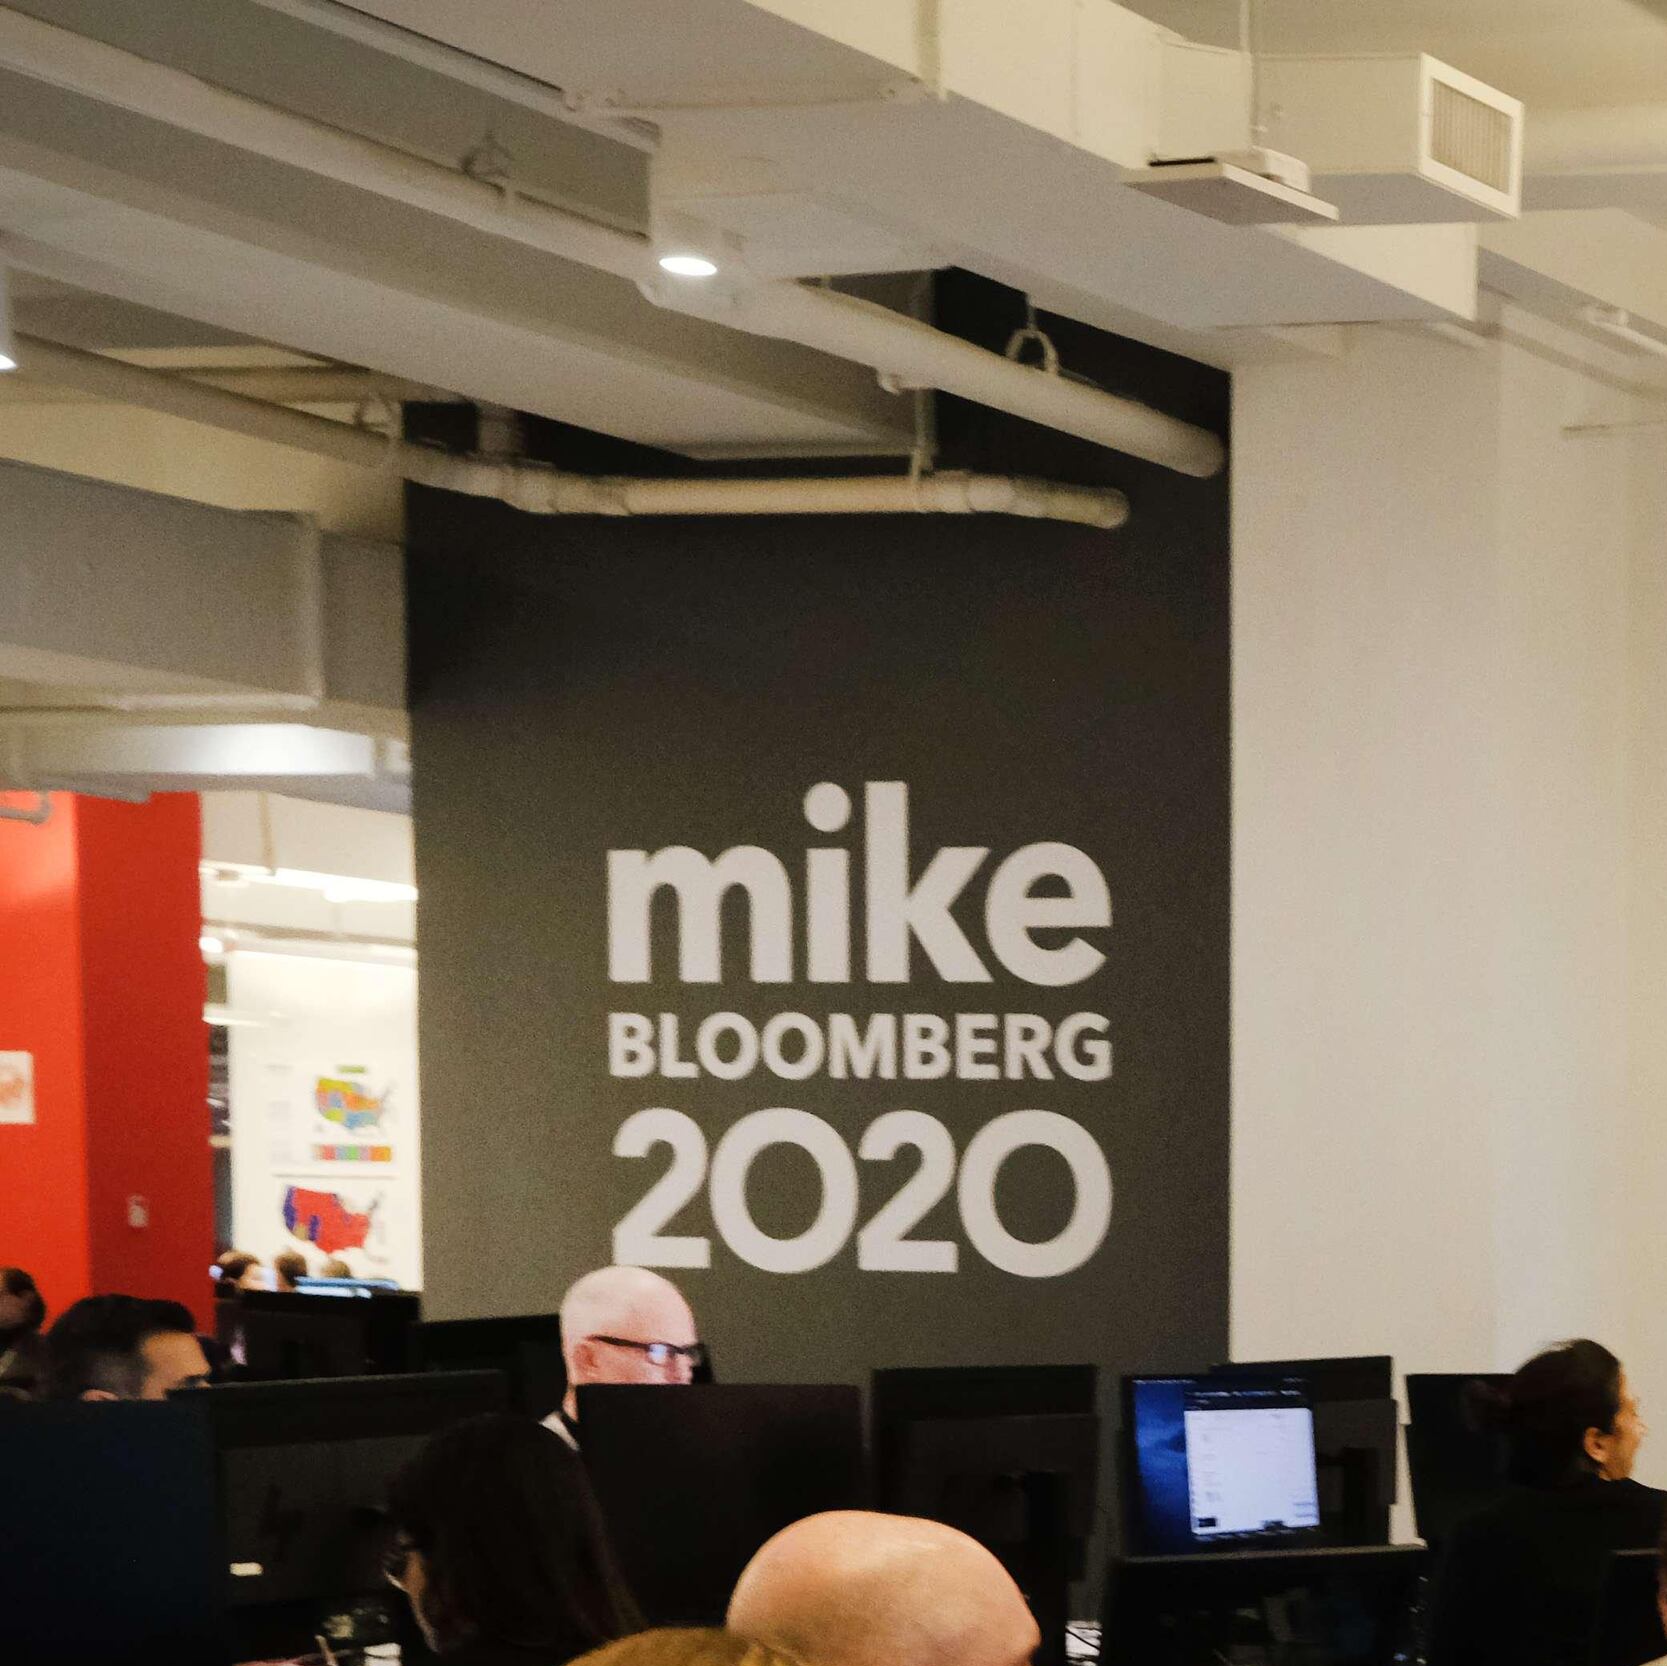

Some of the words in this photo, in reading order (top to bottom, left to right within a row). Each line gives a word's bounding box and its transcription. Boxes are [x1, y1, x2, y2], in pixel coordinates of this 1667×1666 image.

[607, 780, 1113, 987] mike
[608, 1011, 1114, 1081] BLOOMBERG
[612, 1106, 1113, 1278] 2020
